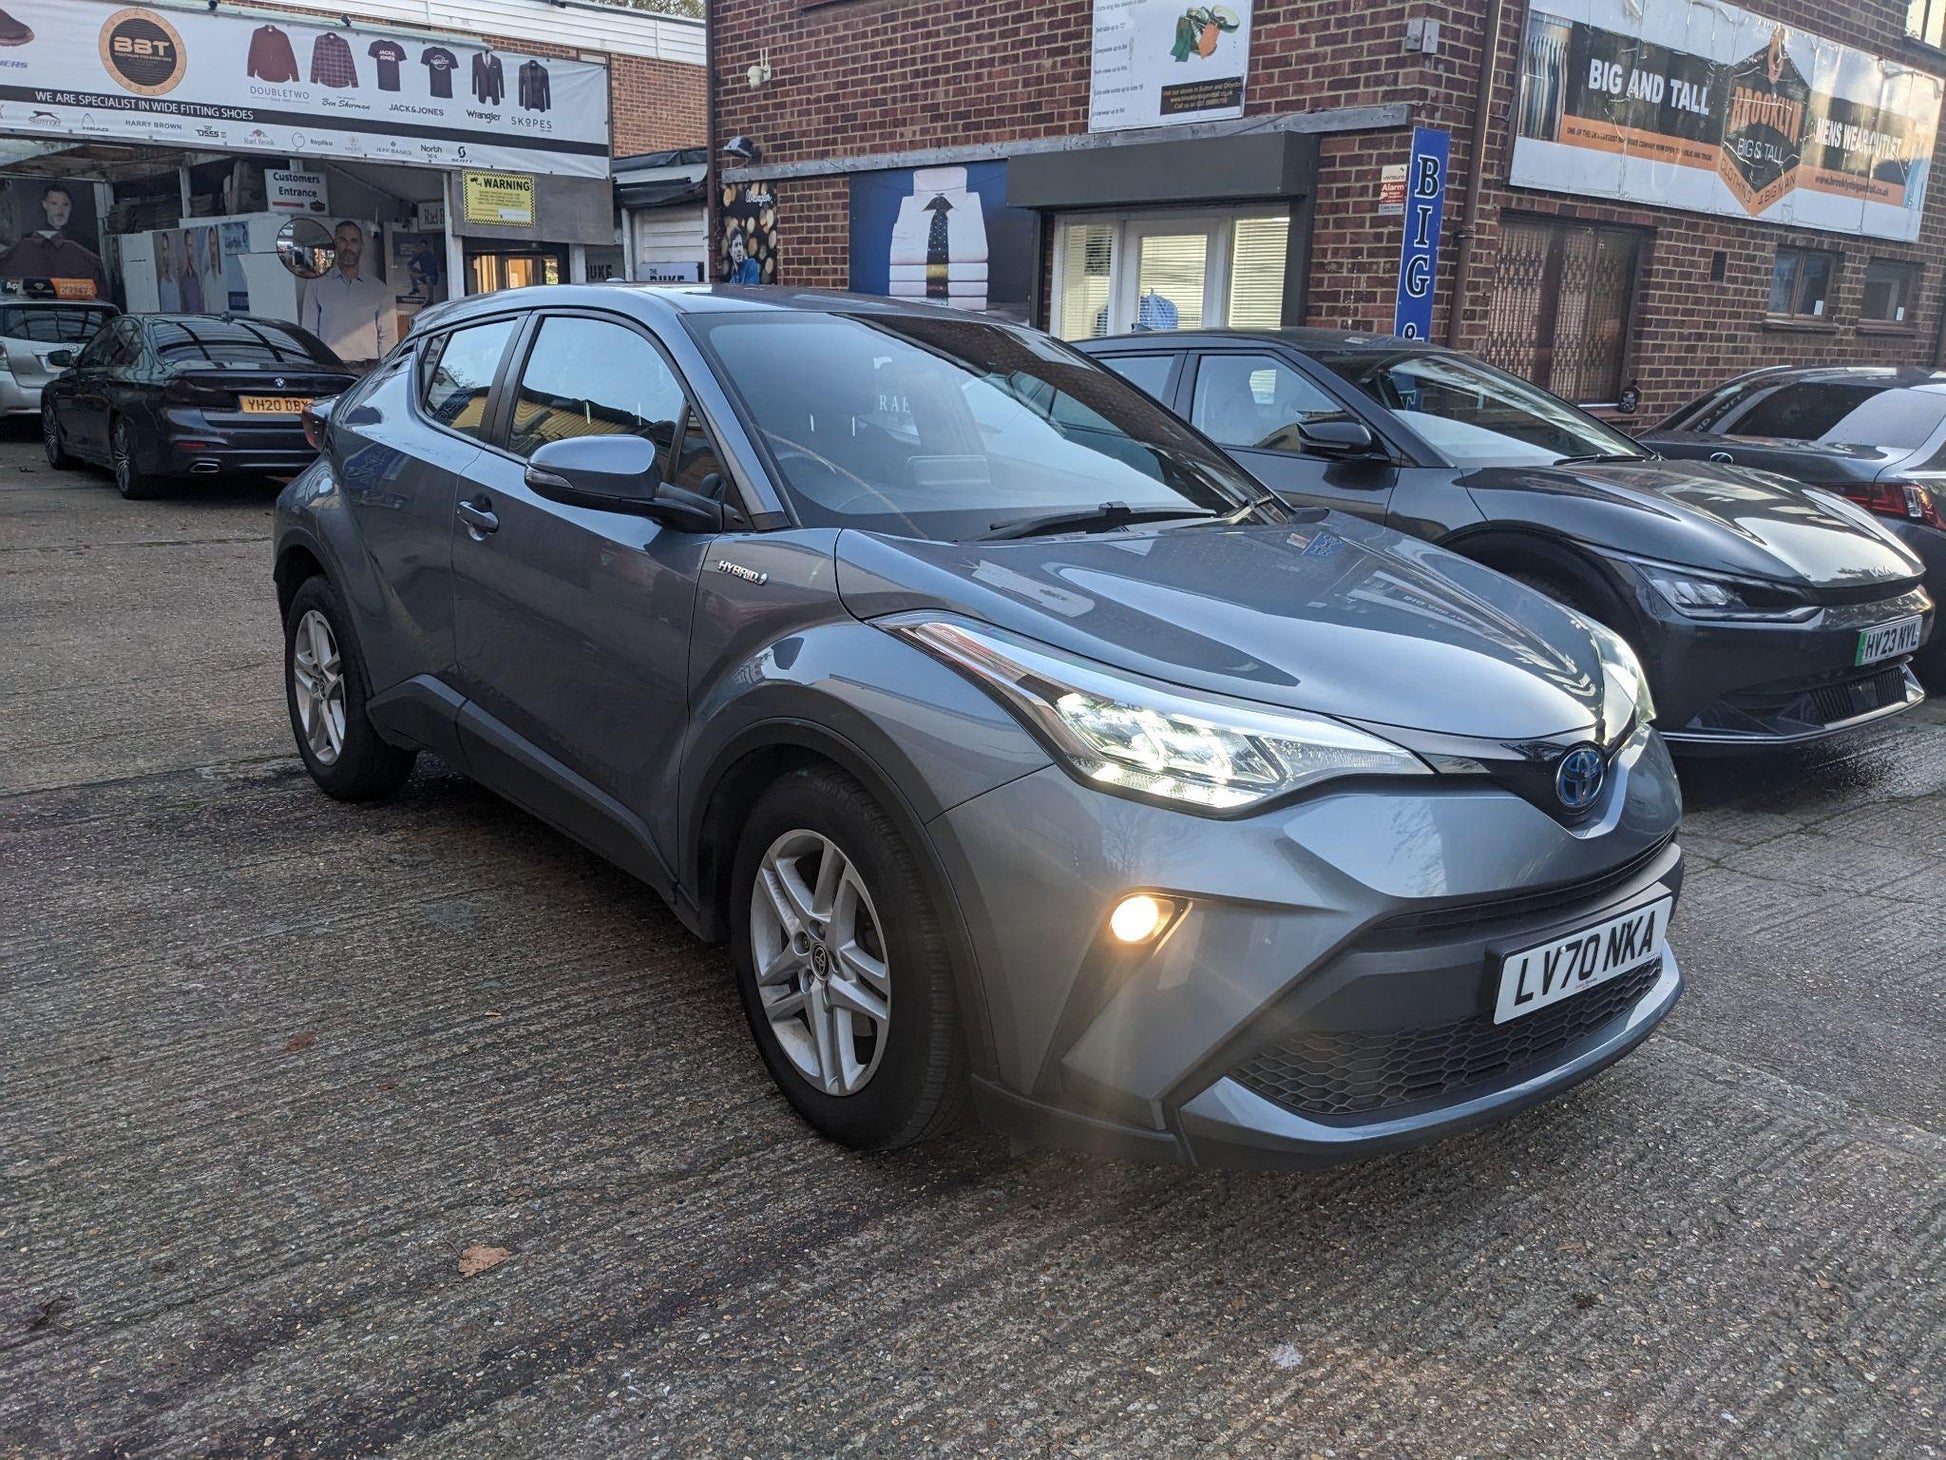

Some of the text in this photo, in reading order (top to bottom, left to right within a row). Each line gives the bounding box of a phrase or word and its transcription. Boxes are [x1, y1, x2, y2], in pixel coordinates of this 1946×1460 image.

[113, 36, 170, 56] BBT
[249, 86, 310, 100] DOUBLETWO
[1588, 58, 1710, 115] BIG AND TALL
[34, 91, 255, 120] WE ARE SPECIALIST IN WIDE FITTING SHOES
[337, 99, 371, 110] Sherman
[466, 109, 502, 123] Wrangler
[511, 116, 552, 129] SKOPES
[1730, 86, 1803, 148] BROOKLYN
[125, 119, 182, 130] HARRY BROWN
[1815, 118, 1842, 148] MENS
[420, 144, 443, 153] North
[1764, 143, 1784, 164] TALL
[272, 172, 320, 184] Customers
[483, 177, 530, 192] WARNING
[278, 186, 318, 198] Entrance
[1381, 183, 1405, 191] Alarm
[1763, 185, 1777, 202] BIG
[1405, 153, 1440, 298] BIG
[585, 264, 613, 280] UKE
[60, 288, 93, 296] DEALER
[247, 399, 281, 411] YH20
[718, 560, 759, 582] HYBRID
[1865, 623, 1917, 659] HV23 NYL
[1514, 910, 1656, 1006] LV70 NKA
